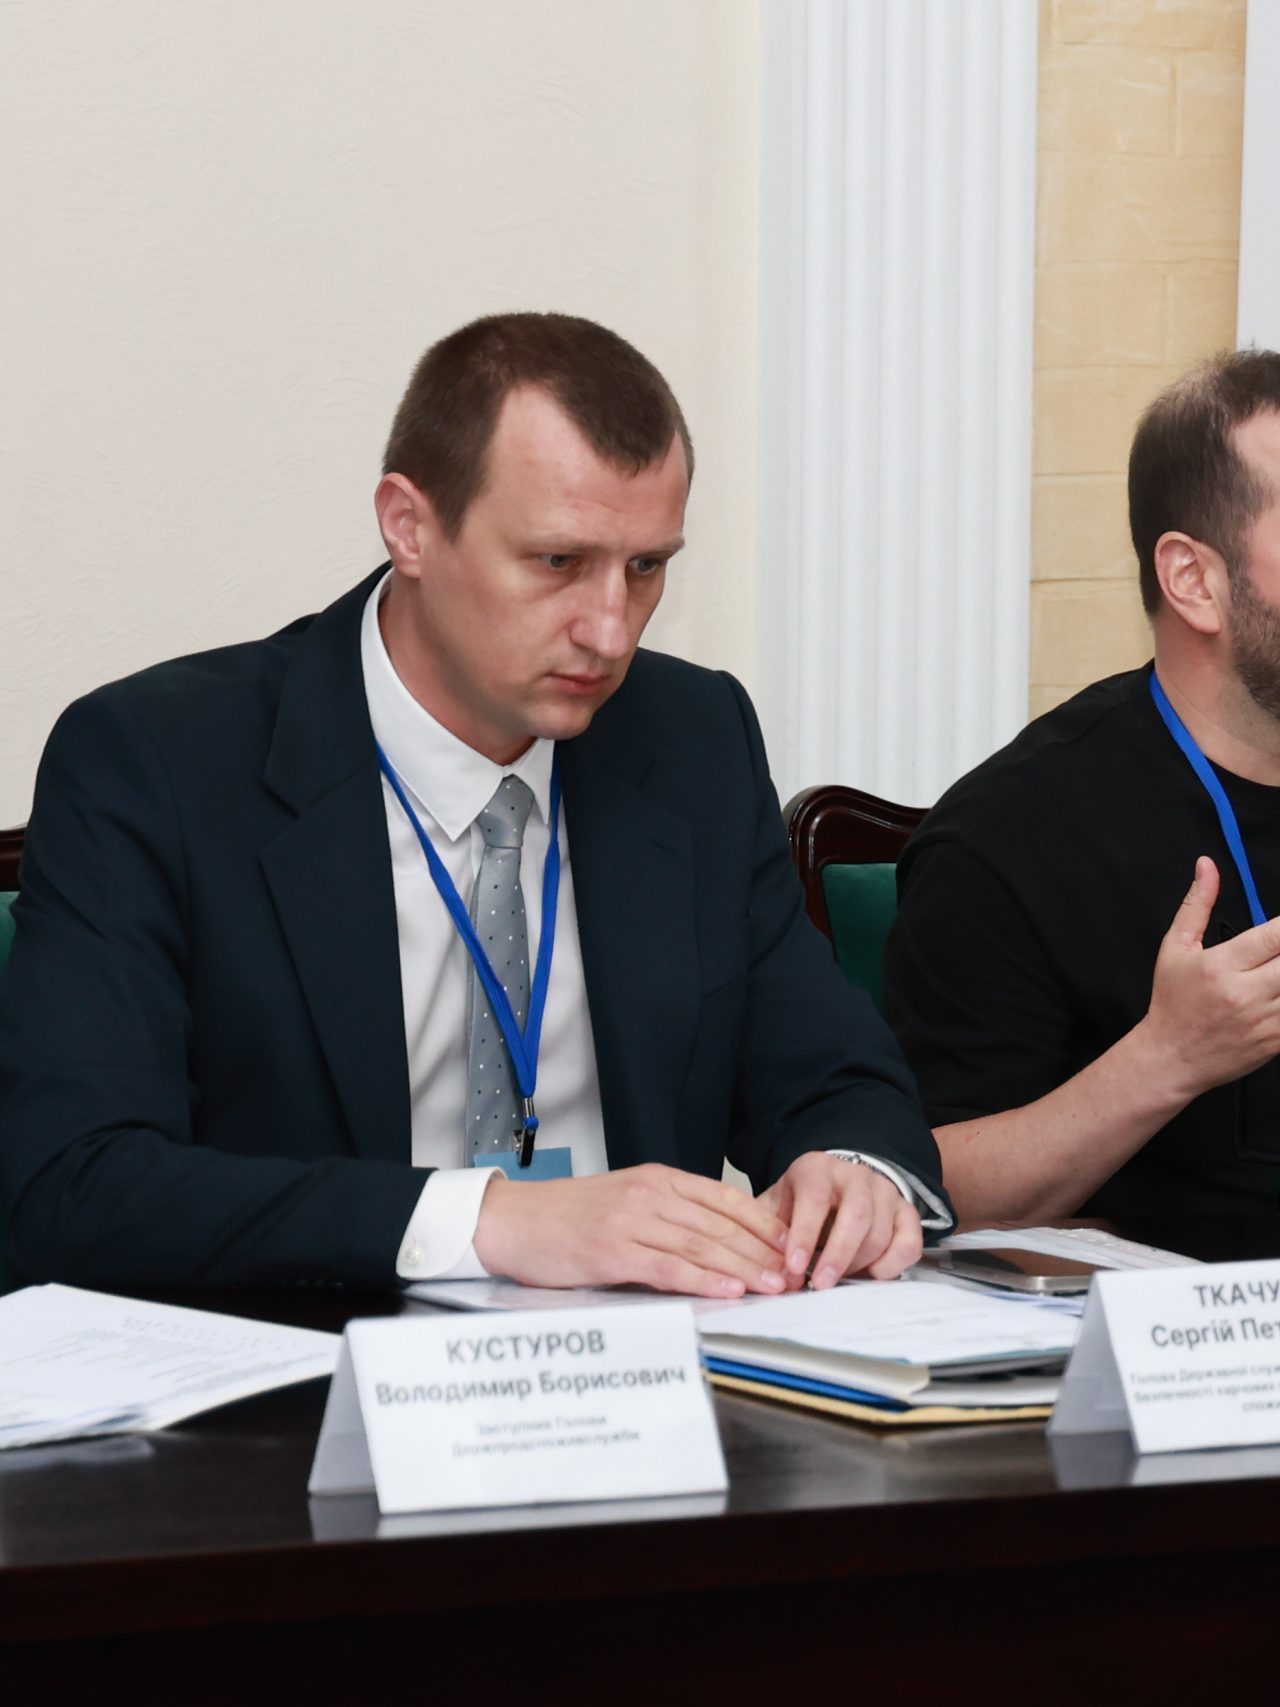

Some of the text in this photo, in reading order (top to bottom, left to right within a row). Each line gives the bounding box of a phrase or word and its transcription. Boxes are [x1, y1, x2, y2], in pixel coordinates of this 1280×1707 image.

[446, 1329, 605, 1364] КУСТУРОВ
[1151, 1319, 1235, 1350] Сергій
[375, 1367, 687, 1406] Володимир Борисович
